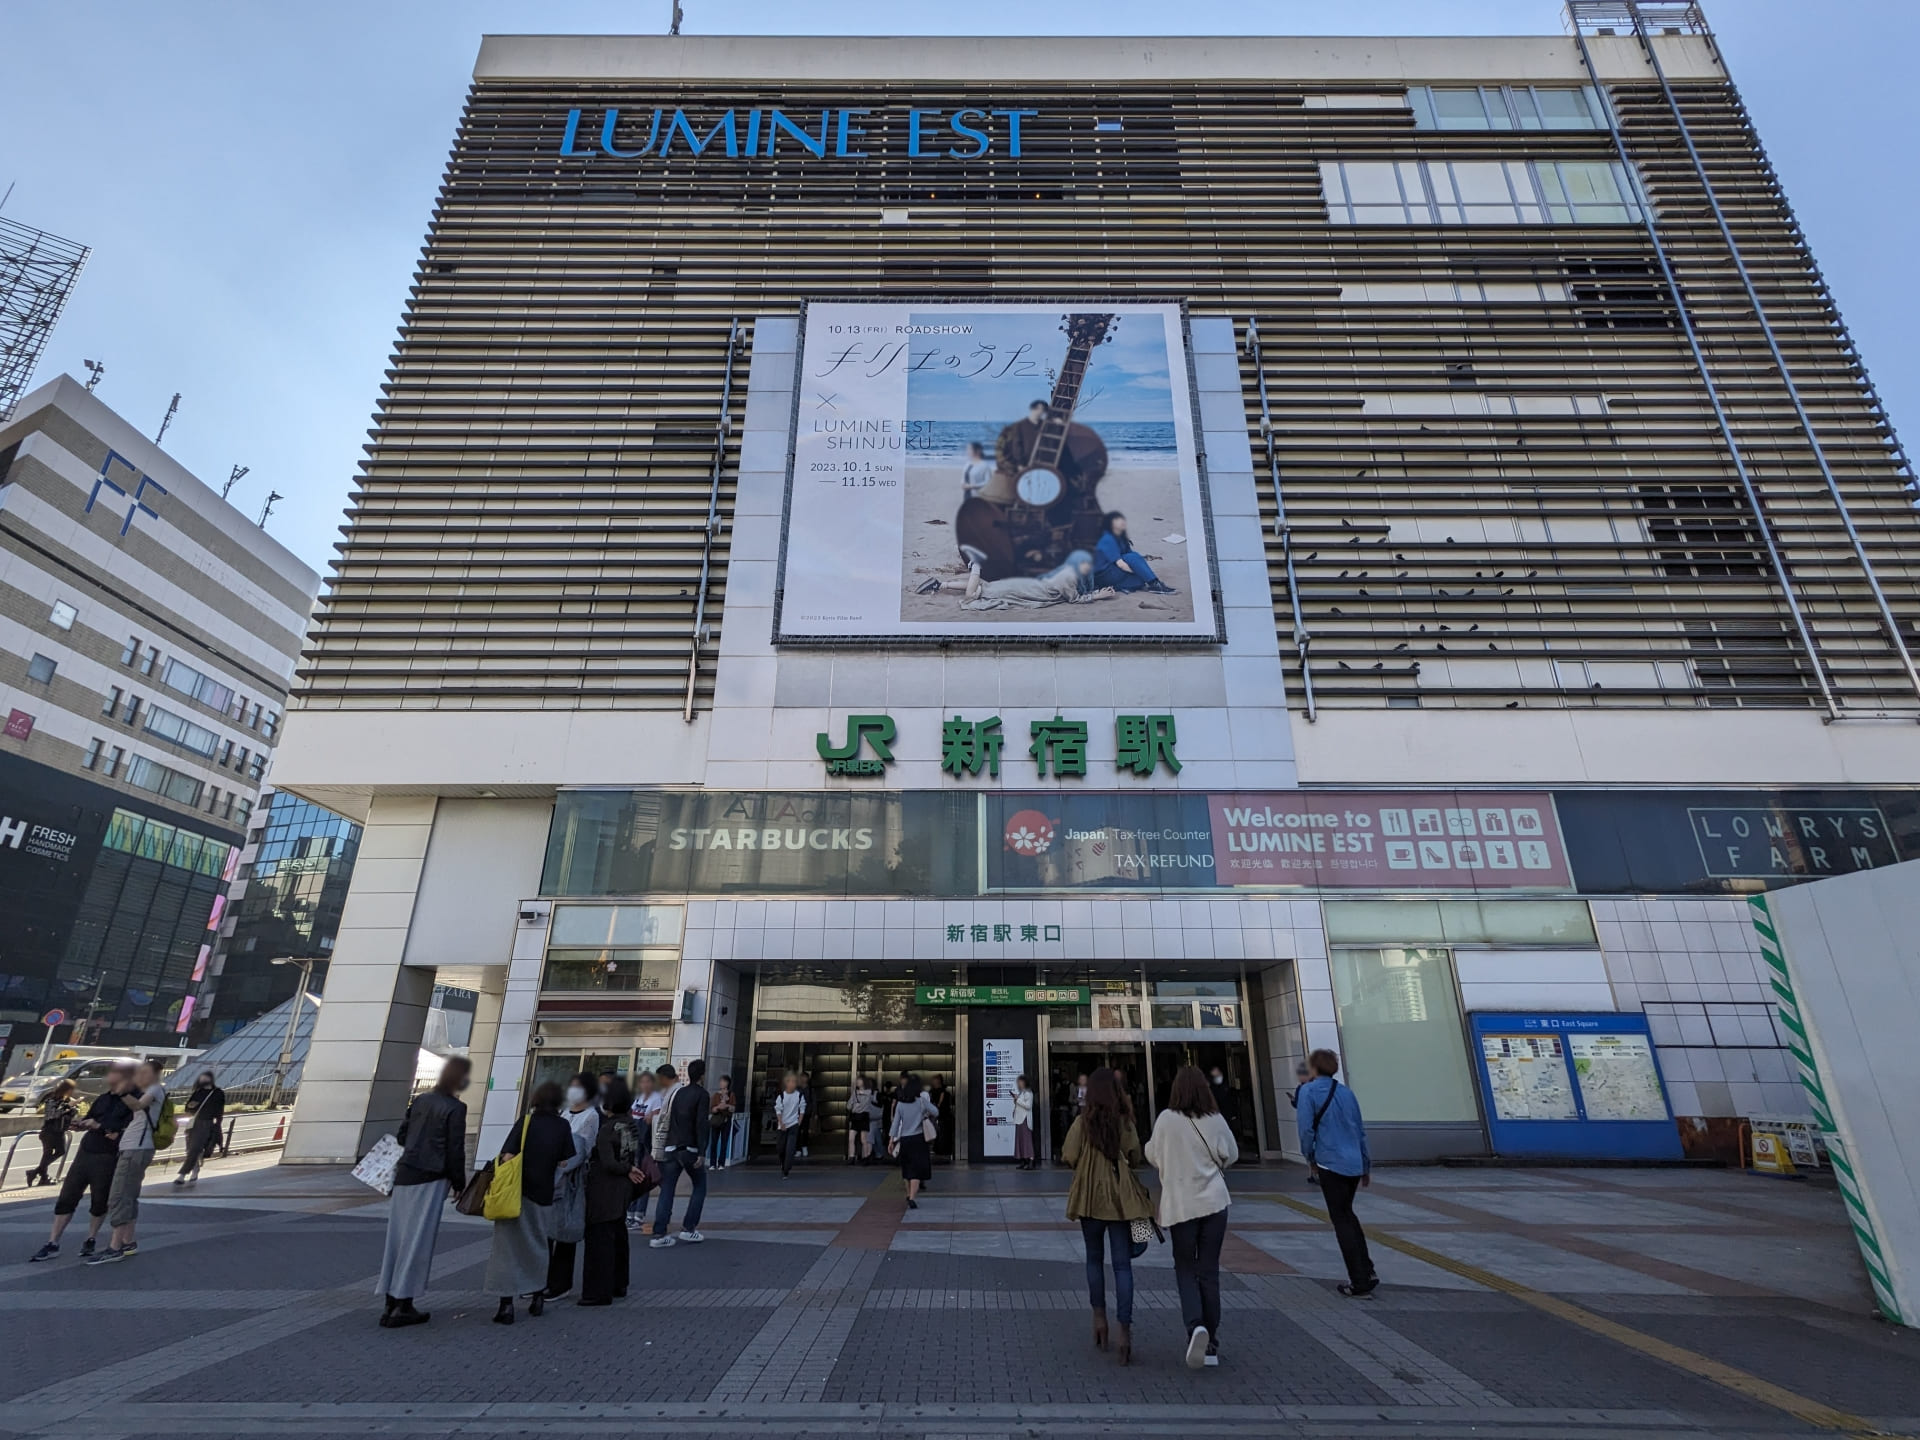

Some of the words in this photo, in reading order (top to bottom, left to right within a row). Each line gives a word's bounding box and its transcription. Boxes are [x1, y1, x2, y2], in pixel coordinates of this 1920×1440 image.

[559, 108, 872, 160] LUMINE
[907, 108, 1039, 160] EST
[895, 324, 973, 335] ROADSHOW
[814, 340, 1040, 379] キリエのうた
[813, 419, 892, 433] LUMINE
[900, 419, 937, 433] EST
[826, 435, 932, 450] SHINJUKU
[874, 464, 894, 473] SUN
[878, 479, 897, 488] WED
[815, 714, 897, 761] JR
[940, 714, 1184, 778] 新宿駅
[826, 759, 886, 776] JR東日本
[1223, 806, 1340, 829] Welcome
[1344, 808, 1372, 829] to
[31, 824, 77, 847] FRESH
[1111, 828, 1161, 841] Tax-free
[1163, 828, 1211, 841] Counter
[1700, 816, 1880, 839] LOWRYS
[27, 837, 73, 855] HANDMADE
[668, 828, 874, 851] STARBUCKS
[1226, 832, 1326, 853] LUMINE
[1332, 832, 1375, 853] EST
[25, 844, 70, 862] COSMETICS
[1113, 854, 1146, 868] TAX
[1149, 854, 1216, 868] REFUND
[1726, 846, 1874, 869] FARM
[926, 987, 946, 1000] JR
[1576, 1020, 1598, 1029] Square
